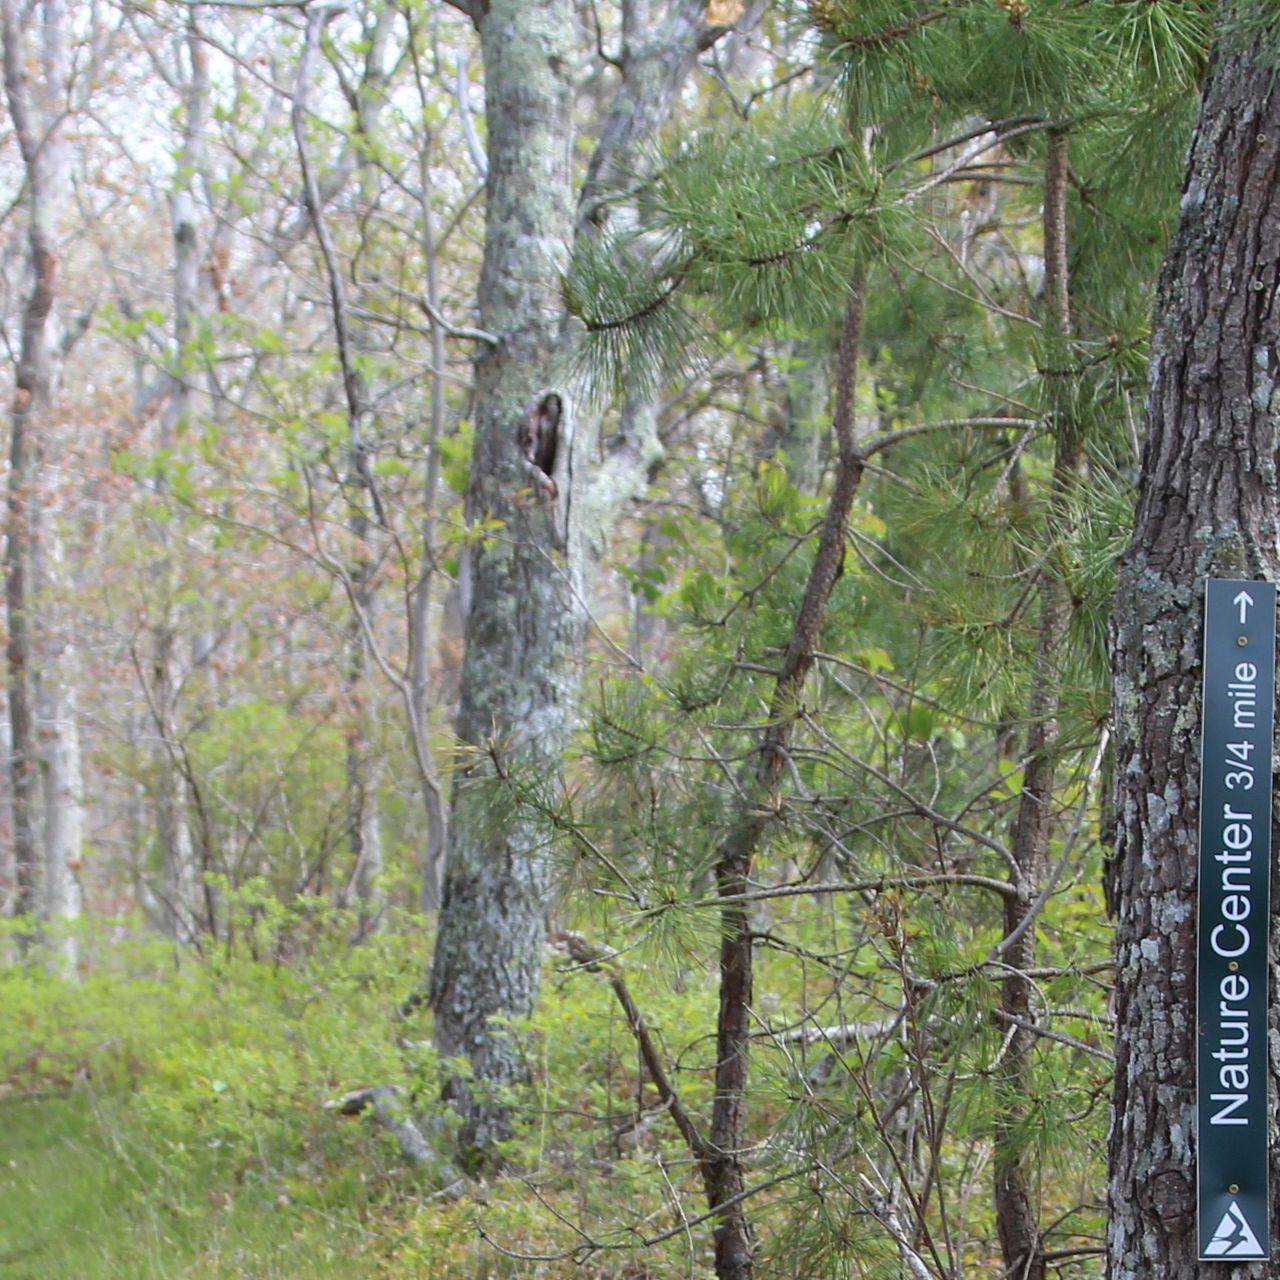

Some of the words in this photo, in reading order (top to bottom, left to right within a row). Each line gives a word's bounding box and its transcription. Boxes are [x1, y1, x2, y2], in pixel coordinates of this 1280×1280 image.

[1227, 661, 1257, 729] mile
[1224, 740, 1255, 791] 3/4
[1210, 803, 1253, 958] Center
[1210, 974, 1251, 1126] Nature
